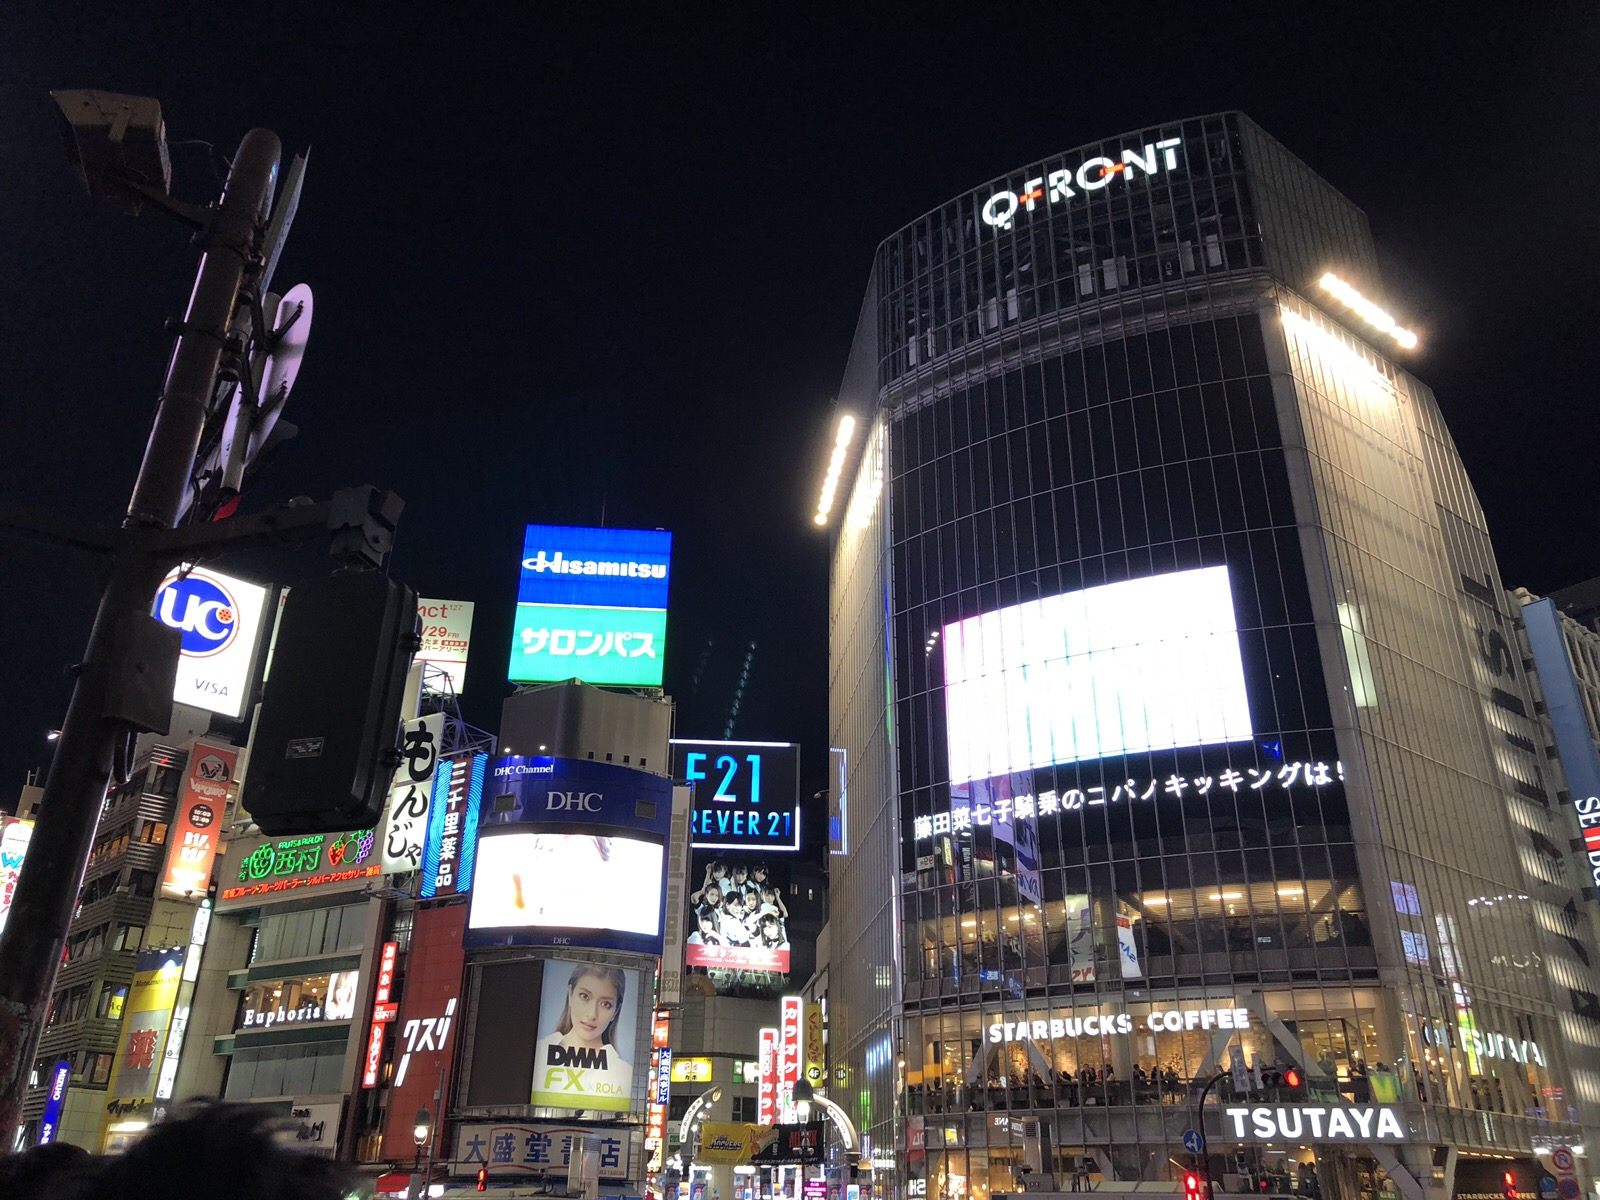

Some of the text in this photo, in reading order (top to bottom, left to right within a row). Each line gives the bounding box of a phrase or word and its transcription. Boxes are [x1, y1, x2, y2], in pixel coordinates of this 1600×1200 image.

[982, 137, 1181, 230] QFRONT
[522, 551, 666, 578] Hisamitsu
[520, 627, 656, 659] サロンパス
[195, 678, 228, 697] VISA
[494, 764, 554, 777] DHC Channel
[387, 720, 437, 866] もんじゃ
[546, 791, 604, 812] DHC
[435, 761, 467, 887] 三千里薬品
[767, 811, 790, 837] 21
[274, 846, 322, 876] 西村
[243, 1004, 321, 1028] Euphoria
[989, 1008, 1250, 1043] STARBUCKS COFFEE
[125, 1029, 159, 1070] 薬
[785, 1007, 797, 1073] カラオケ
[547, 1044, 608, 1070] DMM
[544, 1067, 585, 1091] FX
[595, 1083, 622, 1095] ROLA
[809, 1069, 820, 1078] 4F
[1226, 1107, 1404, 1138] TSUTAYA
